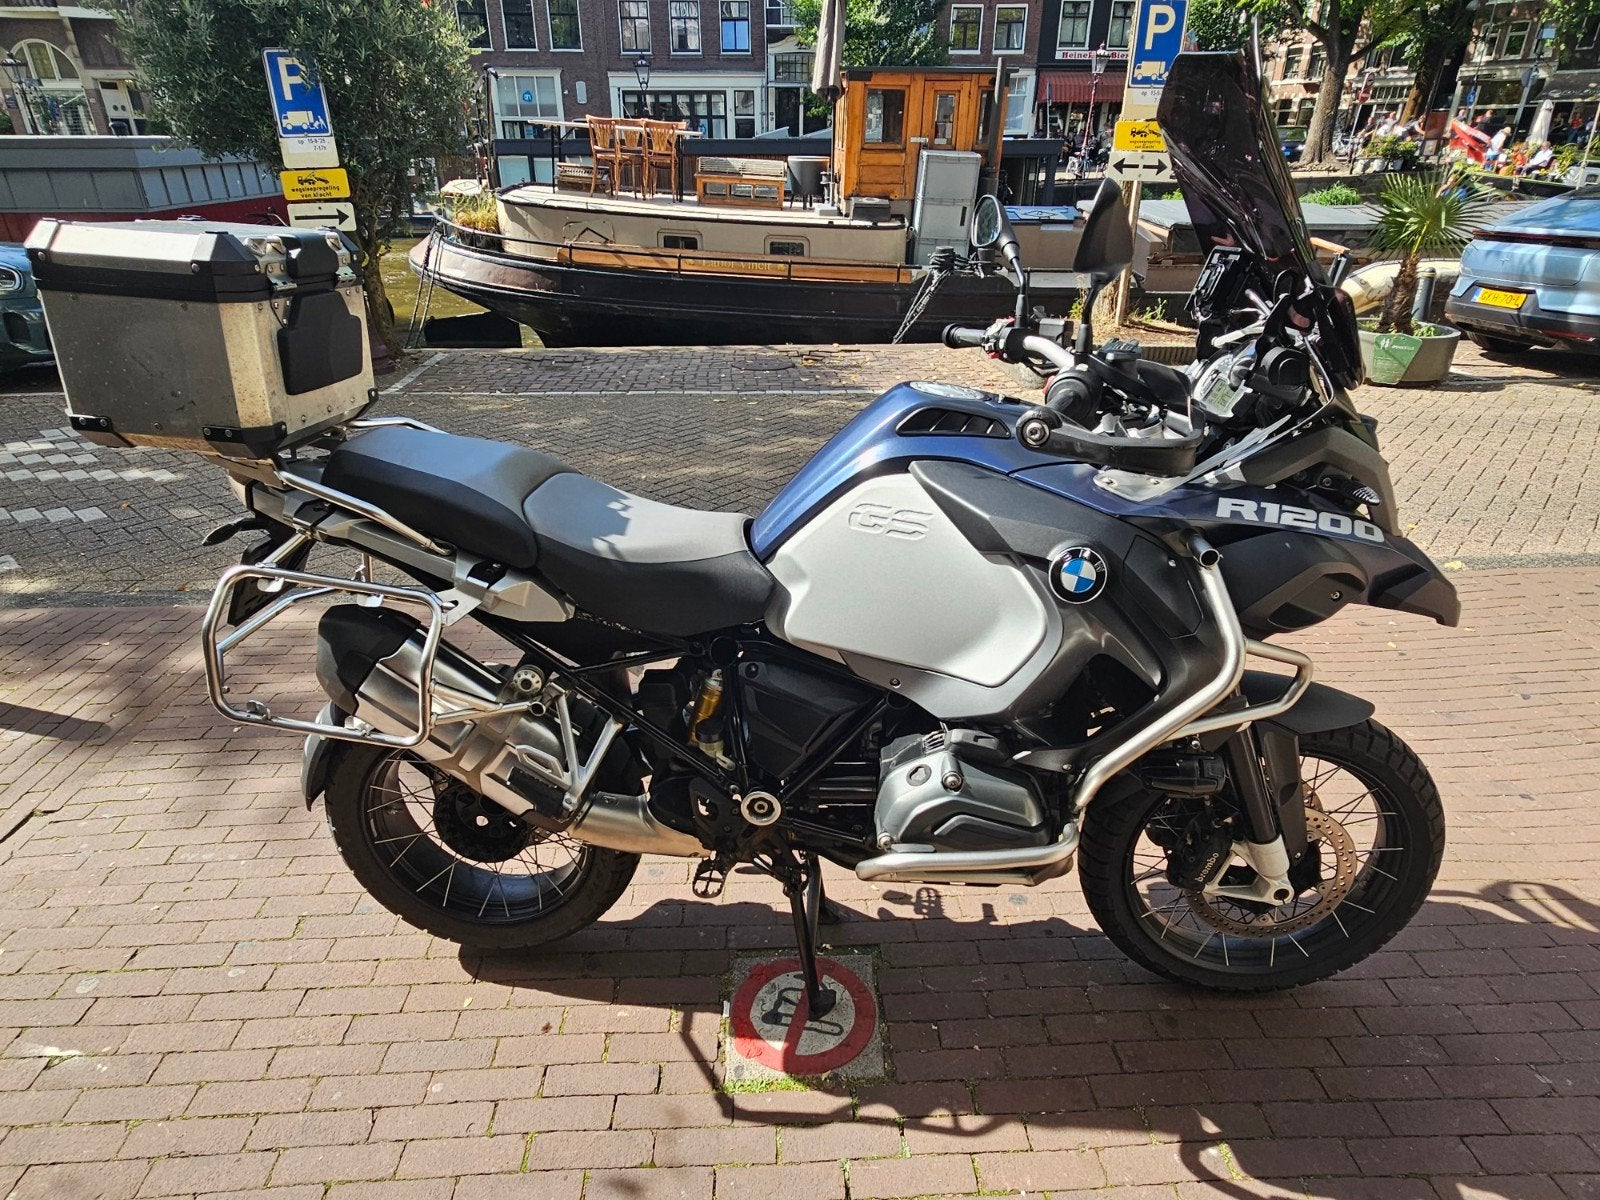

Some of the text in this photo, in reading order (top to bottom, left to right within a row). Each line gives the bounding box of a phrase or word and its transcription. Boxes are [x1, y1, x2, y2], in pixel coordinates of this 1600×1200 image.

[1145, 5, 1176, 50] P
[277, 57, 308, 100] P
[291, 185, 340, 193] wegsleepregeling
[848, 503, 933, 541] GS
[1215, 497, 1385, 543] R1200
[1194, 852, 1219, 882] brembo
